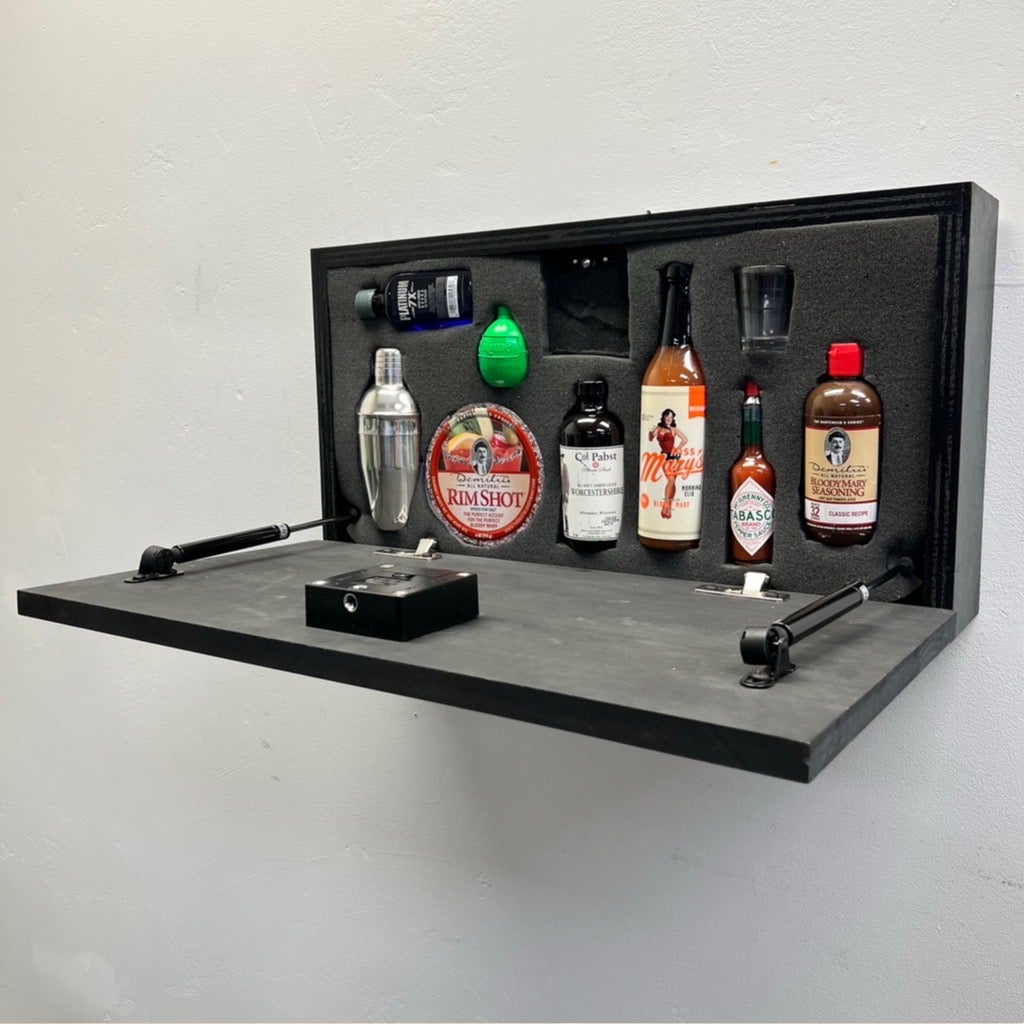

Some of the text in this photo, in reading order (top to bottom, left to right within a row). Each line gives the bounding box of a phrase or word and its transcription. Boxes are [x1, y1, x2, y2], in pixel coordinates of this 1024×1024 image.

[397, 280, 411, 320] PLATINUM
[408, 291, 417, 308] 7X
[592, 452, 617, 461] Pabst
[810, 477, 867, 487] BLOODY MARY
[812, 486, 865, 497] SEASONING
[447, 488, 478, 506] RIM
[480, 489, 523, 508] SHOT
[810, 506, 820, 518] 32
